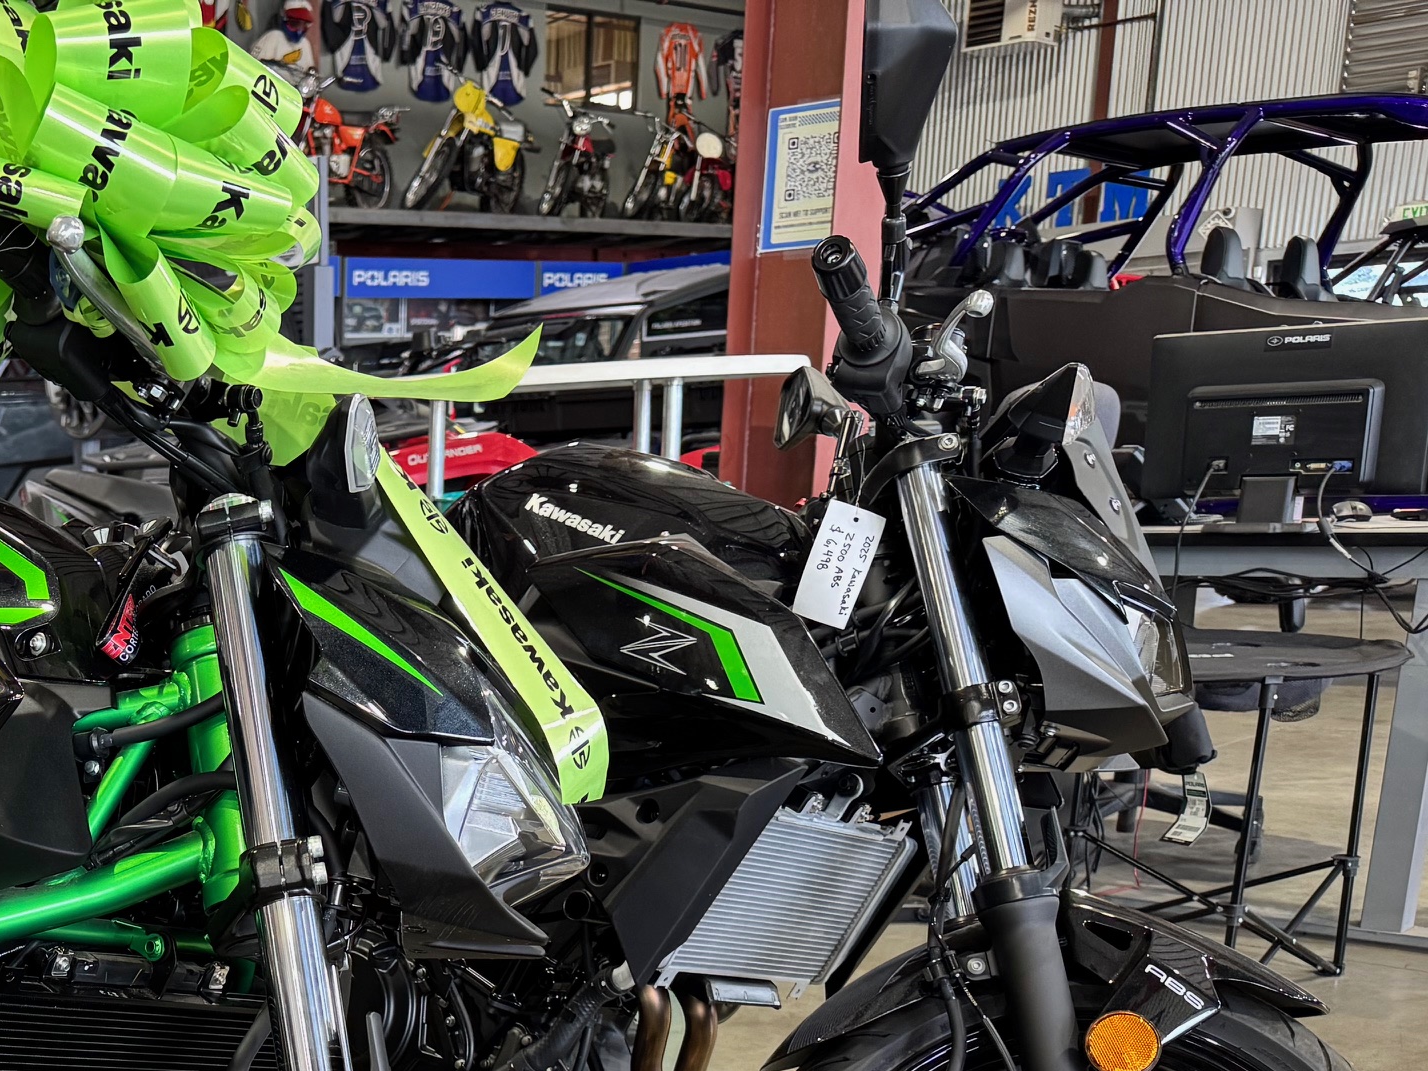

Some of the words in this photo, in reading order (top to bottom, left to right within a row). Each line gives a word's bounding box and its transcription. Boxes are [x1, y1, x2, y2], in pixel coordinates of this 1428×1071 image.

[993, 167, 1151, 228] KTM
[352, 269, 430, 287] POLARIS
[1284, 334, 1332, 344] POLARIS
[523, 493, 626, 545] Kawasaki
[858, 535, 875, 563] 2025
[830, 566, 844, 589] ABS
[837, 568, 863, 616] Kawasaki
[461, 556, 575, 720] Kawasaki
[1144, 963, 1205, 1011] ABS
